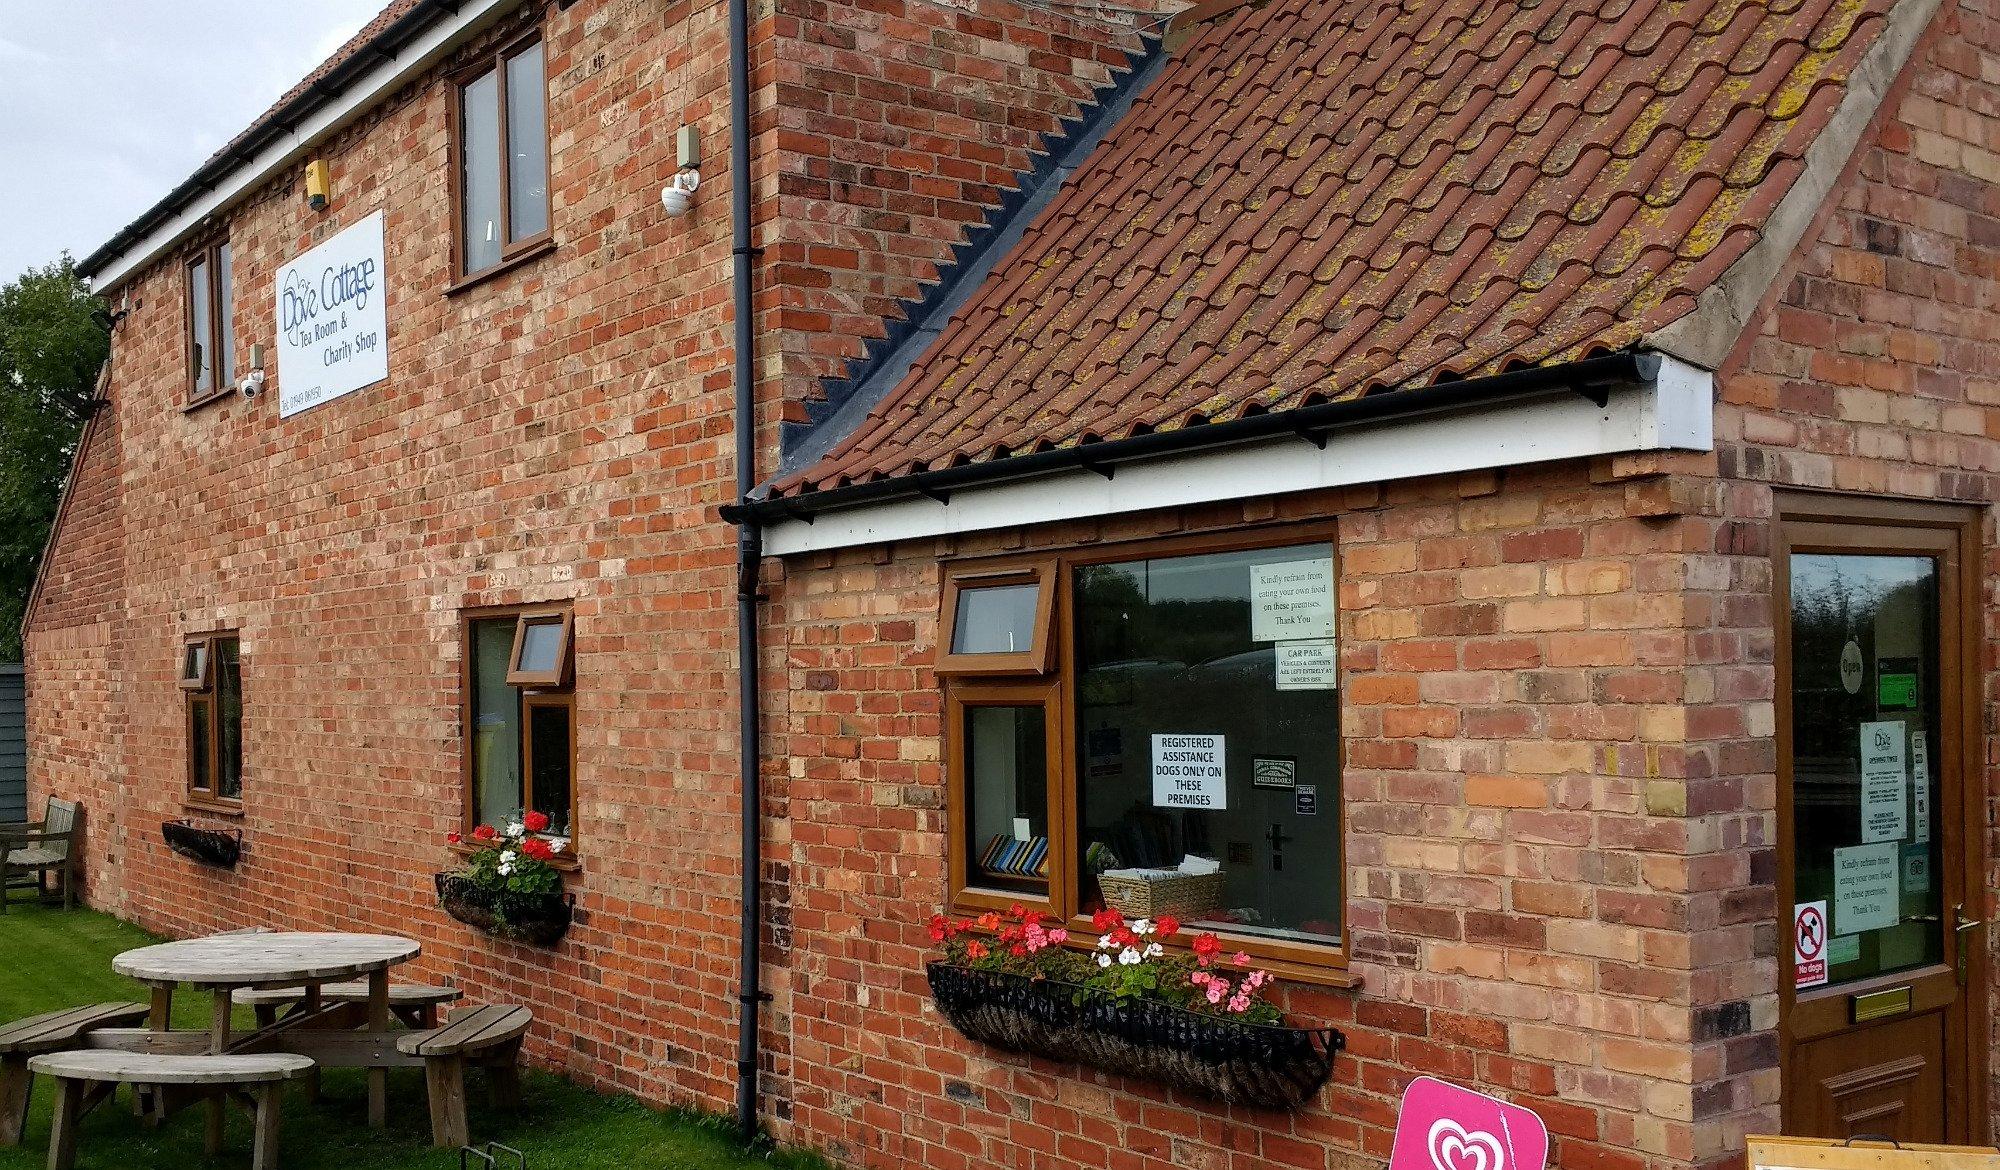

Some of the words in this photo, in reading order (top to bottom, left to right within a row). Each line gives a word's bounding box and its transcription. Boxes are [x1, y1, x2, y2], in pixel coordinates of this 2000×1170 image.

[283, 283, 318, 333] Dove
[321, 257, 375, 311] Cottage
[300, 331, 312, 348] Tea
[315, 319, 338, 342] Room
[341, 311, 348, 328] &
[324, 339, 353, 367] Charity
[356, 330, 377, 354] Shop
[1260, 575, 1281, 585] Kindly
[1284, 573, 1305, 582] refrain
[1307, 571, 1323, 580] from
[1258, 588, 1278, 598] eating
[1279, 587, 1294, 597] your
[1295, 587, 1309, 595] own
[1311, 584, 1326, 594] food
[1273, 602, 1289, 610] these
[1275, 616, 1295, 625] Thank
[1296, 615, 1311, 624] You
[1288, 650, 1302, 658] CAR
[1303, 649, 1323, 657] PARK
[1842, 659, 1860, 675] Open
[1161, 737, 1214, 749] REGISTERED
[1162, 751, 1214, 763] ASSISTANCE
[1156, 765, 1181, 776] DOGS
[1182, 765, 1206, 777] ONLY
[1207, 767, 1222, 777] ON
[1174, 779, 1202, 791] THESE
[1167, 793, 1211, 806] PREMISES
[1841, 857, 1860, 871] Kindly
[1877, 856, 1890, 866] from
[1840, 873, 1855, 886] eating
[1856, 873, 1867, 884] your
[1868, 873, 1879, 882] own
[1880, 870, 1893, 881] food
[1843, 890, 1850, 899] on
[1852, 904, 1868, 915] Thank
[1869, 903, 1881, 914] You
[1799, 964, 1807, 974] No
[1808, 963, 1822, 974] dogs
